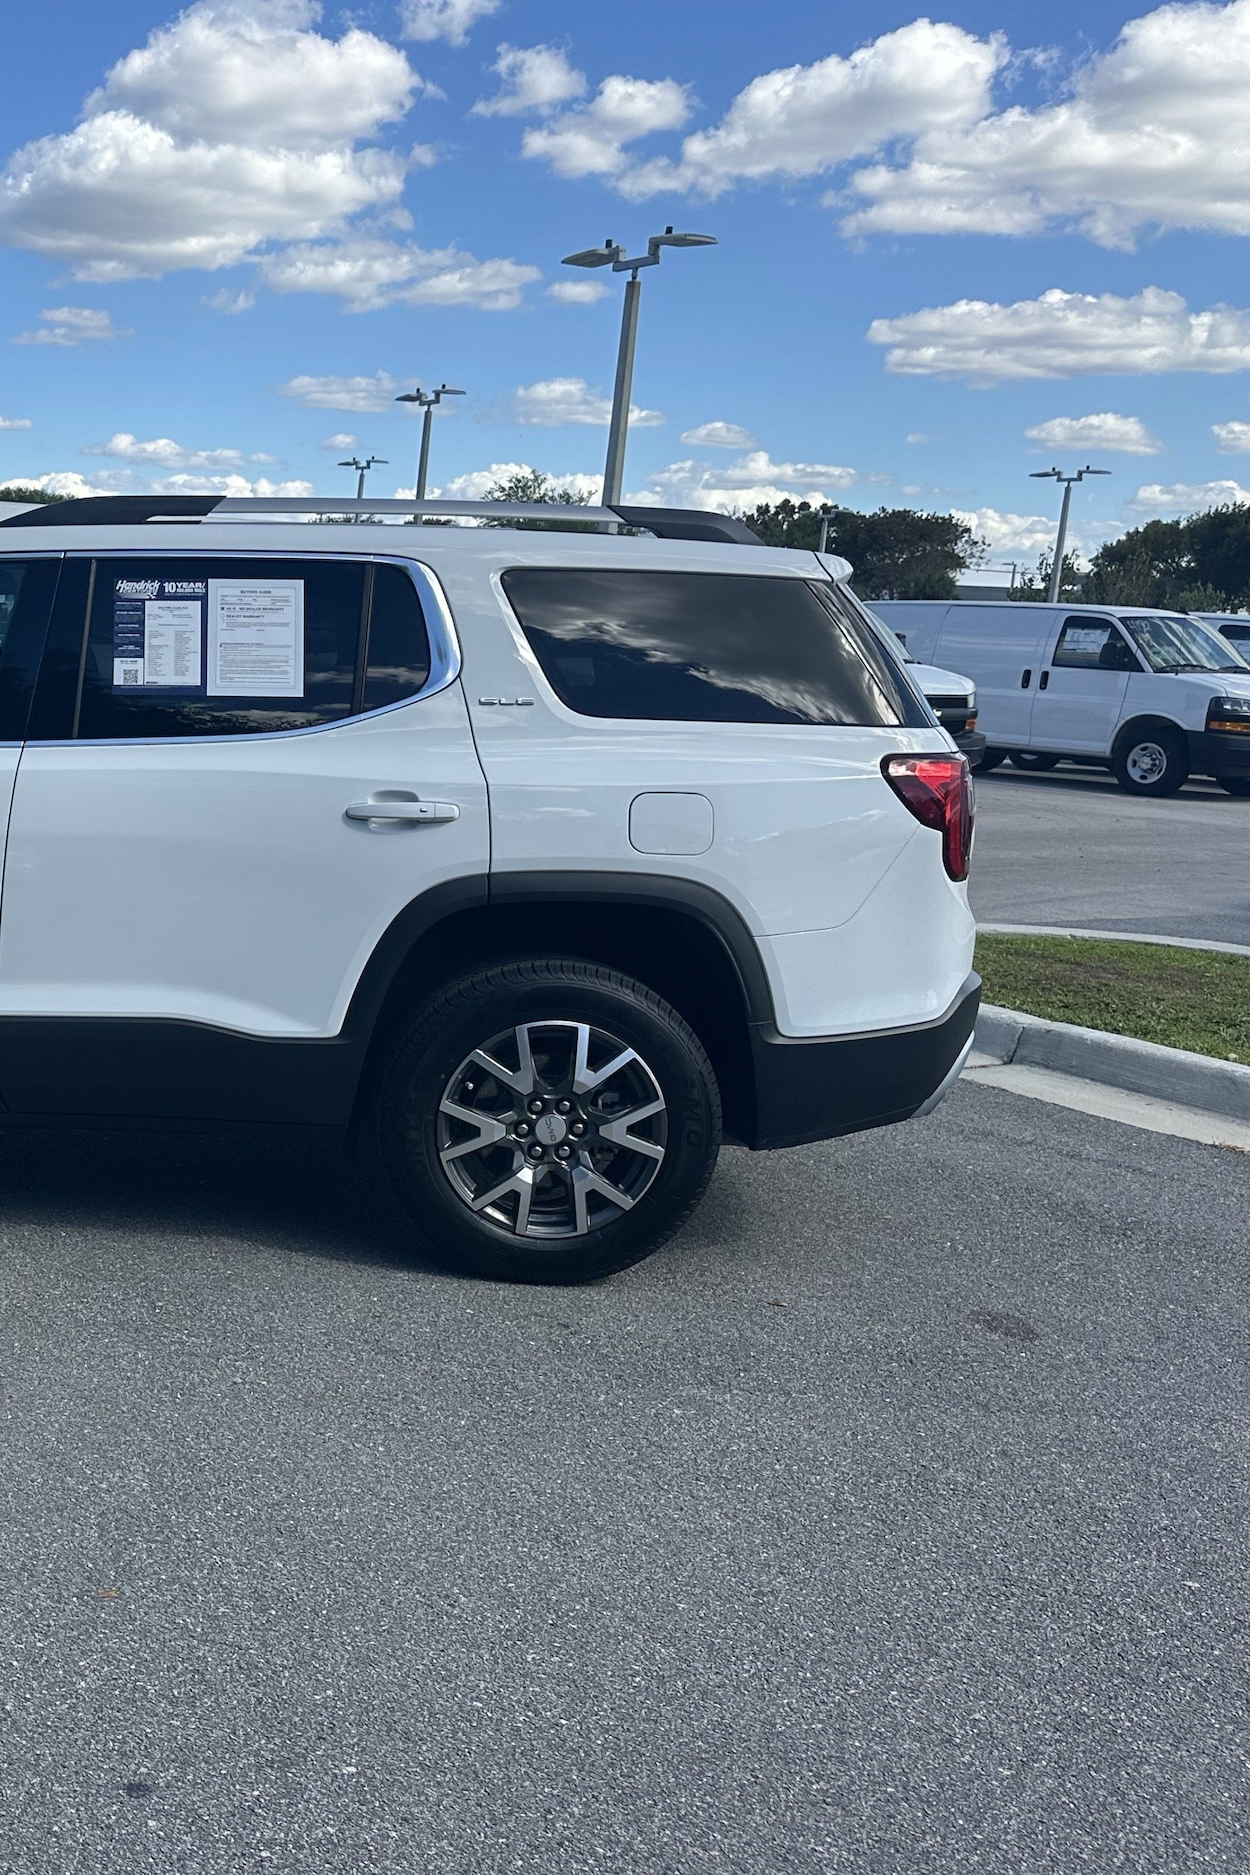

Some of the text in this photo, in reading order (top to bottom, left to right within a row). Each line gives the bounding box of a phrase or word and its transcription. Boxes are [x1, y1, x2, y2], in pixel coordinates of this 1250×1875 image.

[115, 580, 160, 593] Hendrick
[163, 582, 176, 593] 10
[478, 697, 535, 706] SLE
[545, 1117, 557, 1142] GMC
